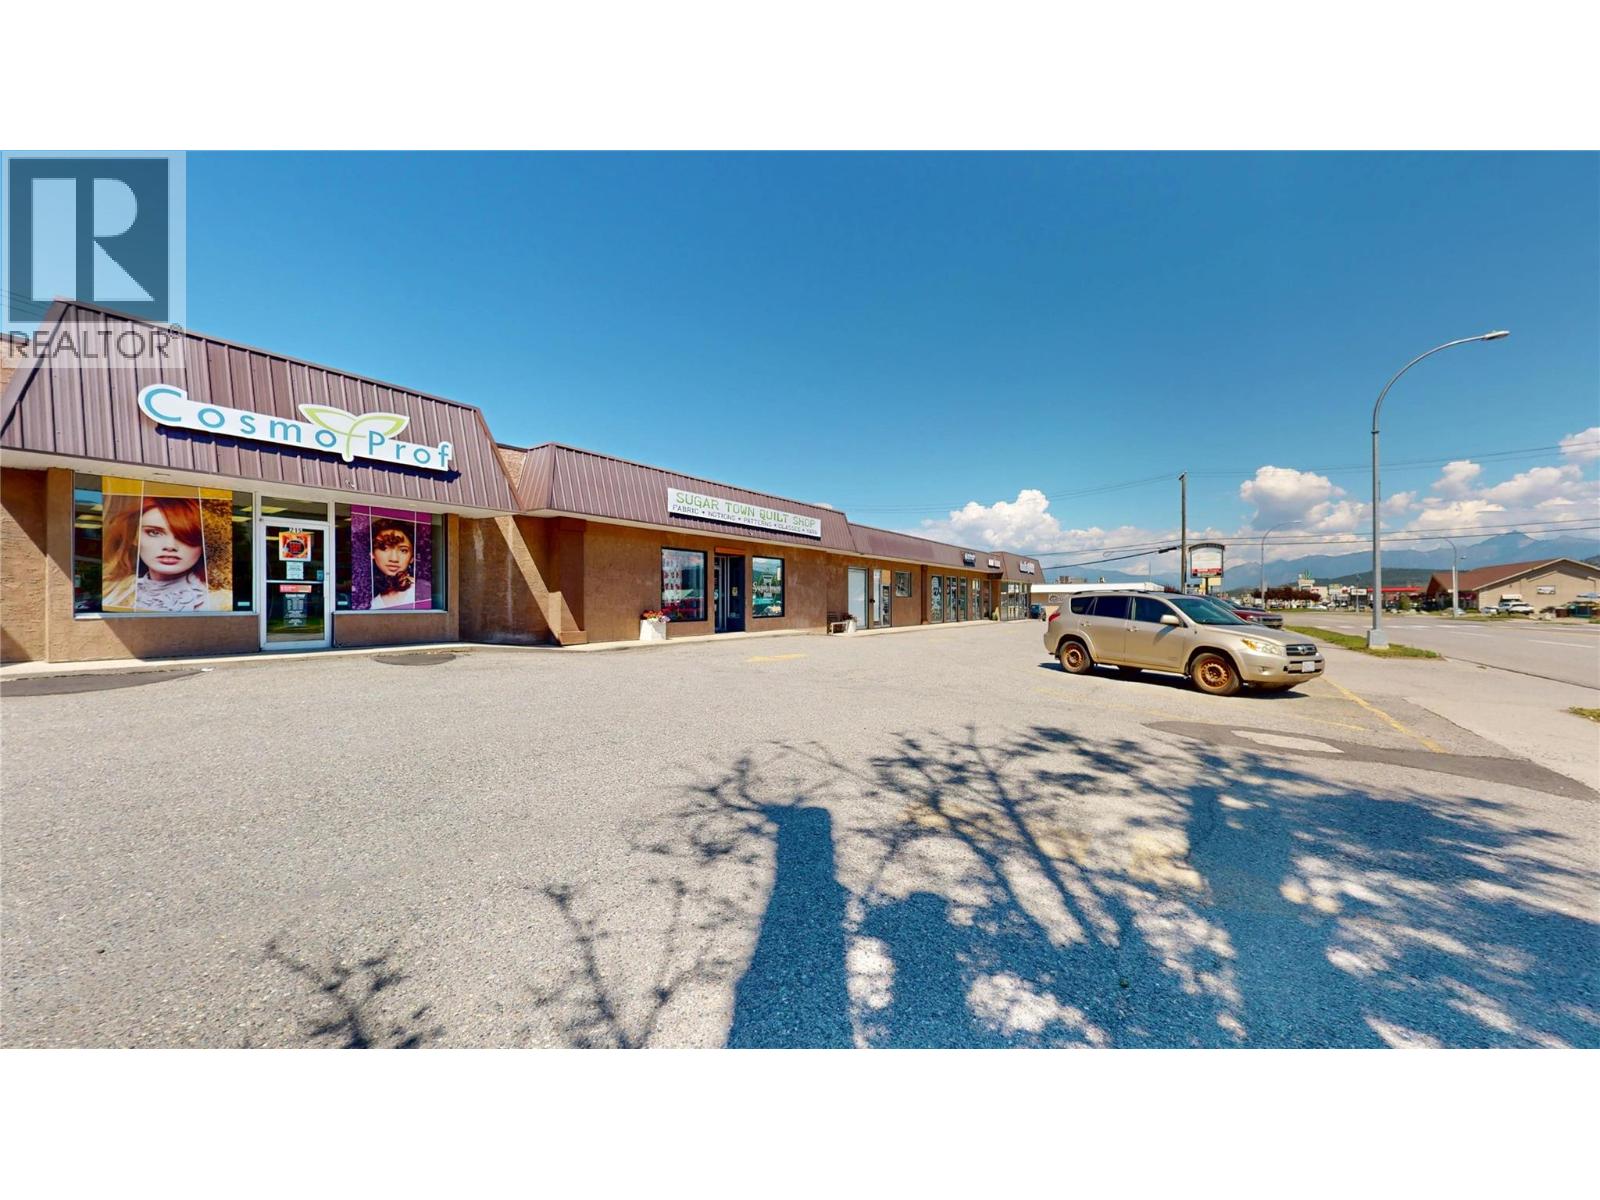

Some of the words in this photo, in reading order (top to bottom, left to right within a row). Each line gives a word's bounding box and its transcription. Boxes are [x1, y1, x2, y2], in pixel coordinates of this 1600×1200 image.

[144, 387, 337, 449] Cosmo
[368, 430, 450, 468] Prof
[672, 504, 700, 515] FABRIC
[707, 510, 736, 521] NOTIONS
[675, 492, 719, 511] SUGAR
[725, 502, 755, 518] TOWN
[759, 509, 789, 524] QUILT
[792, 516, 816, 528] SHOP
